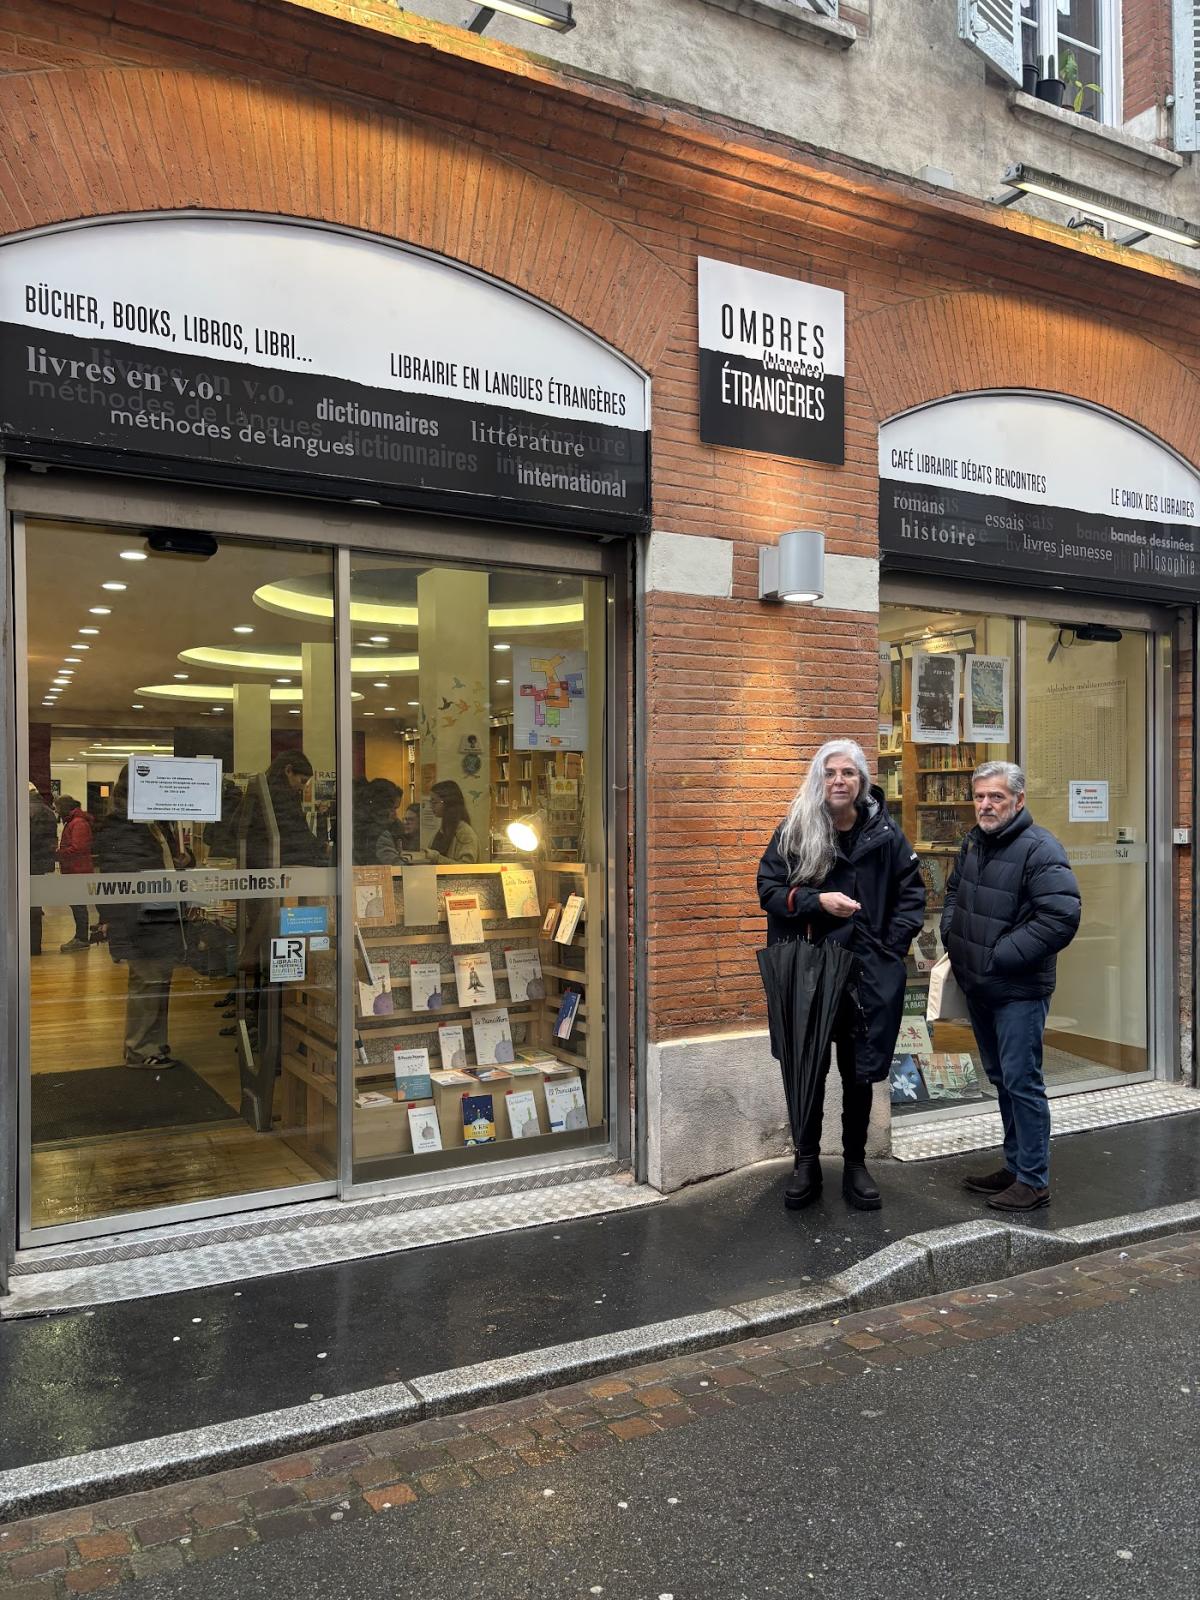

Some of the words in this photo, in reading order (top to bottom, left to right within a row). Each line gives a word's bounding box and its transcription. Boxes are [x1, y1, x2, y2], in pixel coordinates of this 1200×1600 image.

[25, 283, 104, 329] BÜCHER,
[113, 301, 176, 341] BOOKS,
[184, 314, 248, 354] LIBROS,
[255, 328, 313, 362] LIBRI...
[721, 303, 824, 360] OMBRES
[26, 345, 116, 385] livres
[126, 370, 162, 393] en
[172, 377, 223, 402] v.o.
[763, 350, 825, 382] (blanches)
[390, 352, 457, 387] LIBRAIRIE
[463, 366, 480, 391] EN
[485, 370, 543, 402] LANGUES
[548, 377, 626, 416] ÉTRANGÈRES
[721, 361, 825, 421] ÉTRANGÈRES
[110, 409, 231, 440] méthodes
[239, 425, 266, 445] de
[273, 428, 355, 458] langues
[316, 398, 439, 437] dictionnaires
[470, 420, 585, 458] littérature
[517, 465, 626, 498] international
[891, 447, 914, 470] CAFÉ
[917, 452, 959, 478] LIBRAIRIE
[961, 457, 993, 485] DÉBATS
[995, 467, 1047, 494] RENCONTRES
[892, 494, 945, 515] romans
[1111, 488, 1120, 506] LE
[1121, 490, 1143, 509] CHOIX
[1145, 495, 1158, 512] DES
[1160, 497, 1194, 518] LIBRAIRES
[900, 517, 977, 547] histoire
[985, 513, 1024, 531] essais
[1110, 527, 1147, 546] bandes
[1149, 534, 1194, 552] dessinées
[1022, 533, 1057, 553] livres
[1059, 541, 1112, 561] jeunesse
[1133, 550, 1195, 578] philosophie
